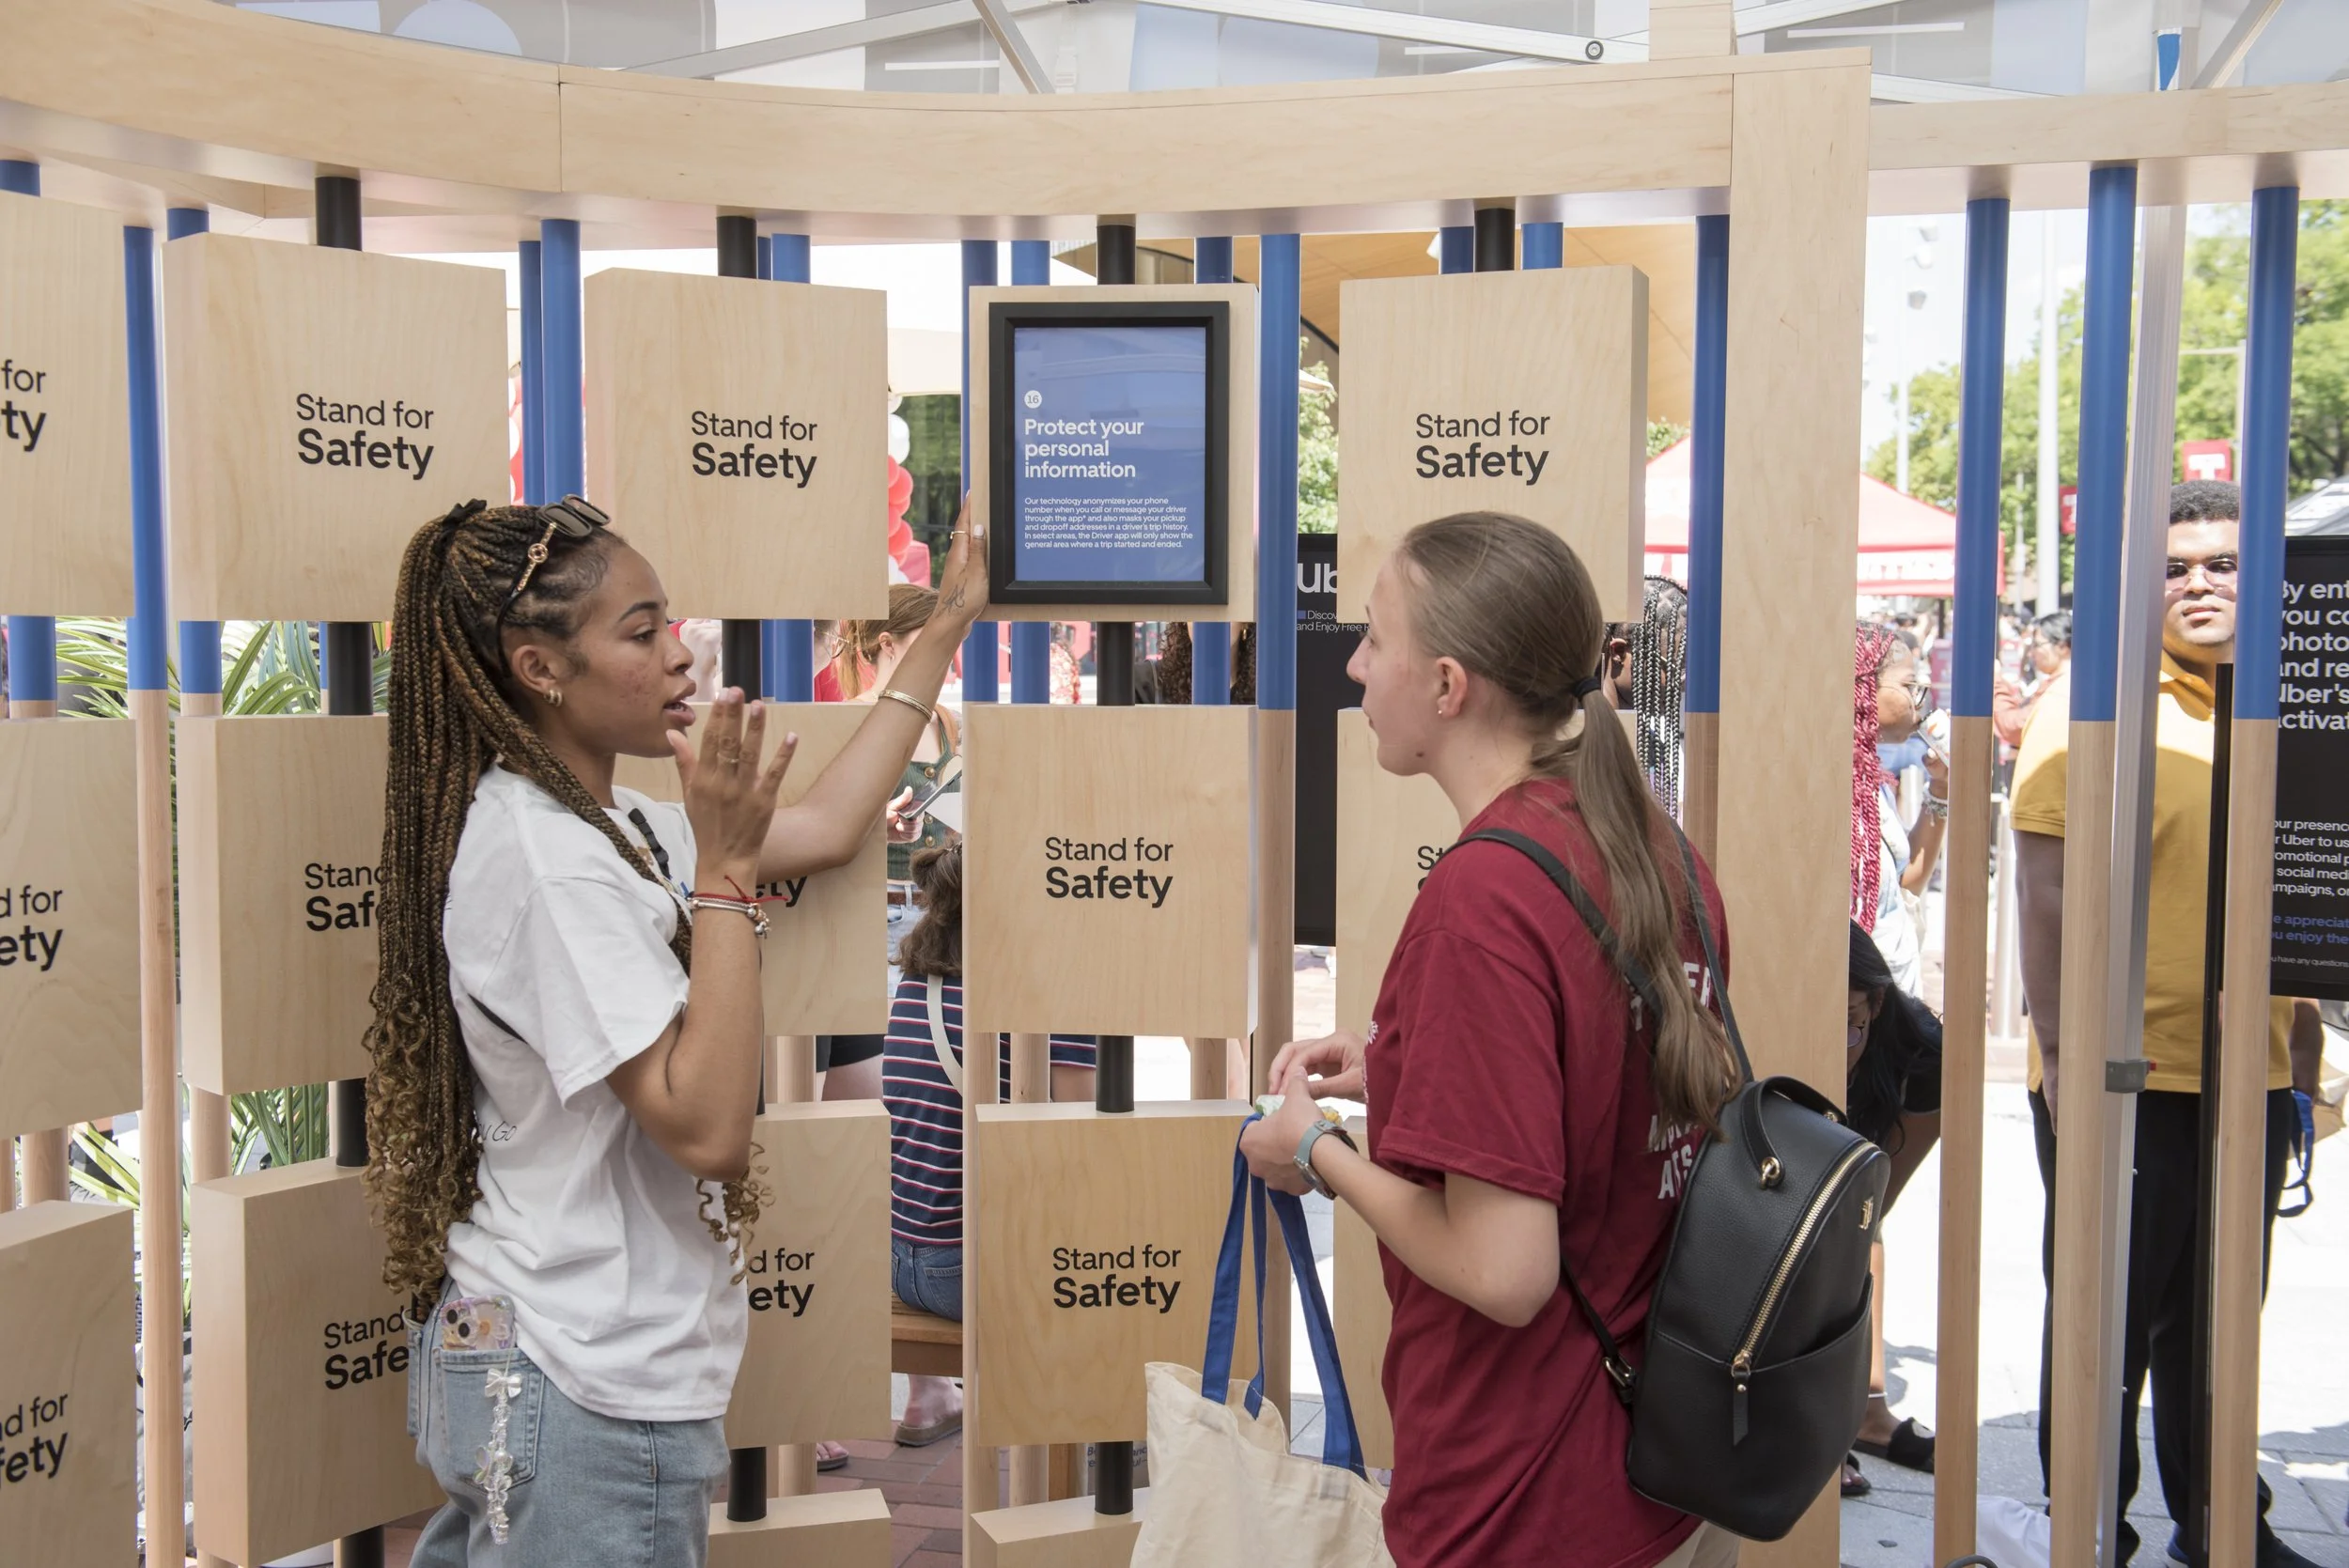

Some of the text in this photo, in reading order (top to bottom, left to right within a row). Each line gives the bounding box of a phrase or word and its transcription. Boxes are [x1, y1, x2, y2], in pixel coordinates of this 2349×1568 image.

[0, 359, 46, 394] for
[296, 393, 434, 429] Stand for
[692, 411, 817, 442] Stand for
[1024, 419, 1144, 439] Protect your
[1416, 410, 1550, 439] Stand for
[298, 427, 434, 481] Safety
[1024, 439, 1109, 461] personal
[692, 442, 817, 489] Safety
[1024, 460, 1136, 478] information
[1416, 444, 1549, 486] Safety
[1024, 497, 1169, 506] Our technology anonymizes your phone
[1165, 505, 1187, 514] driver
[1024, 515, 1053, 523] through
[1160, 515, 1186, 523] pickup
[1040, 523, 1068, 532] dropoff
[1162, 523, 1189, 532] history.
[1024, 541, 1052, 550] general
[1143, 532, 1159, 540] only
[1315, 621, 1340, 633] Enjoy
[2279, 657, 2320, 677] nd
[1045, 836, 1174, 862] Stand for
[2282, 833, 2316, 846] Uber
[2317, 836, 2333, 847] to
[2277, 866, 2315, 878] social
[1046, 865, 1174, 908] Safety
[2272, 883, 2336, 897] mpaigns,
[19, 884, 63, 916] for
[305, 890, 381, 933] Saf
[2286, 930, 2324, 946] enjoy
[773, 1247, 816, 1273] for
[1052, 1243, 1182, 1272] Stand for
[1052, 1273, 1181, 1314] Safety
[323, 1304, 406, 1350] Stand
[29, 1392, 69, 1429] for
[0, 1431, 69, 1490] ety
